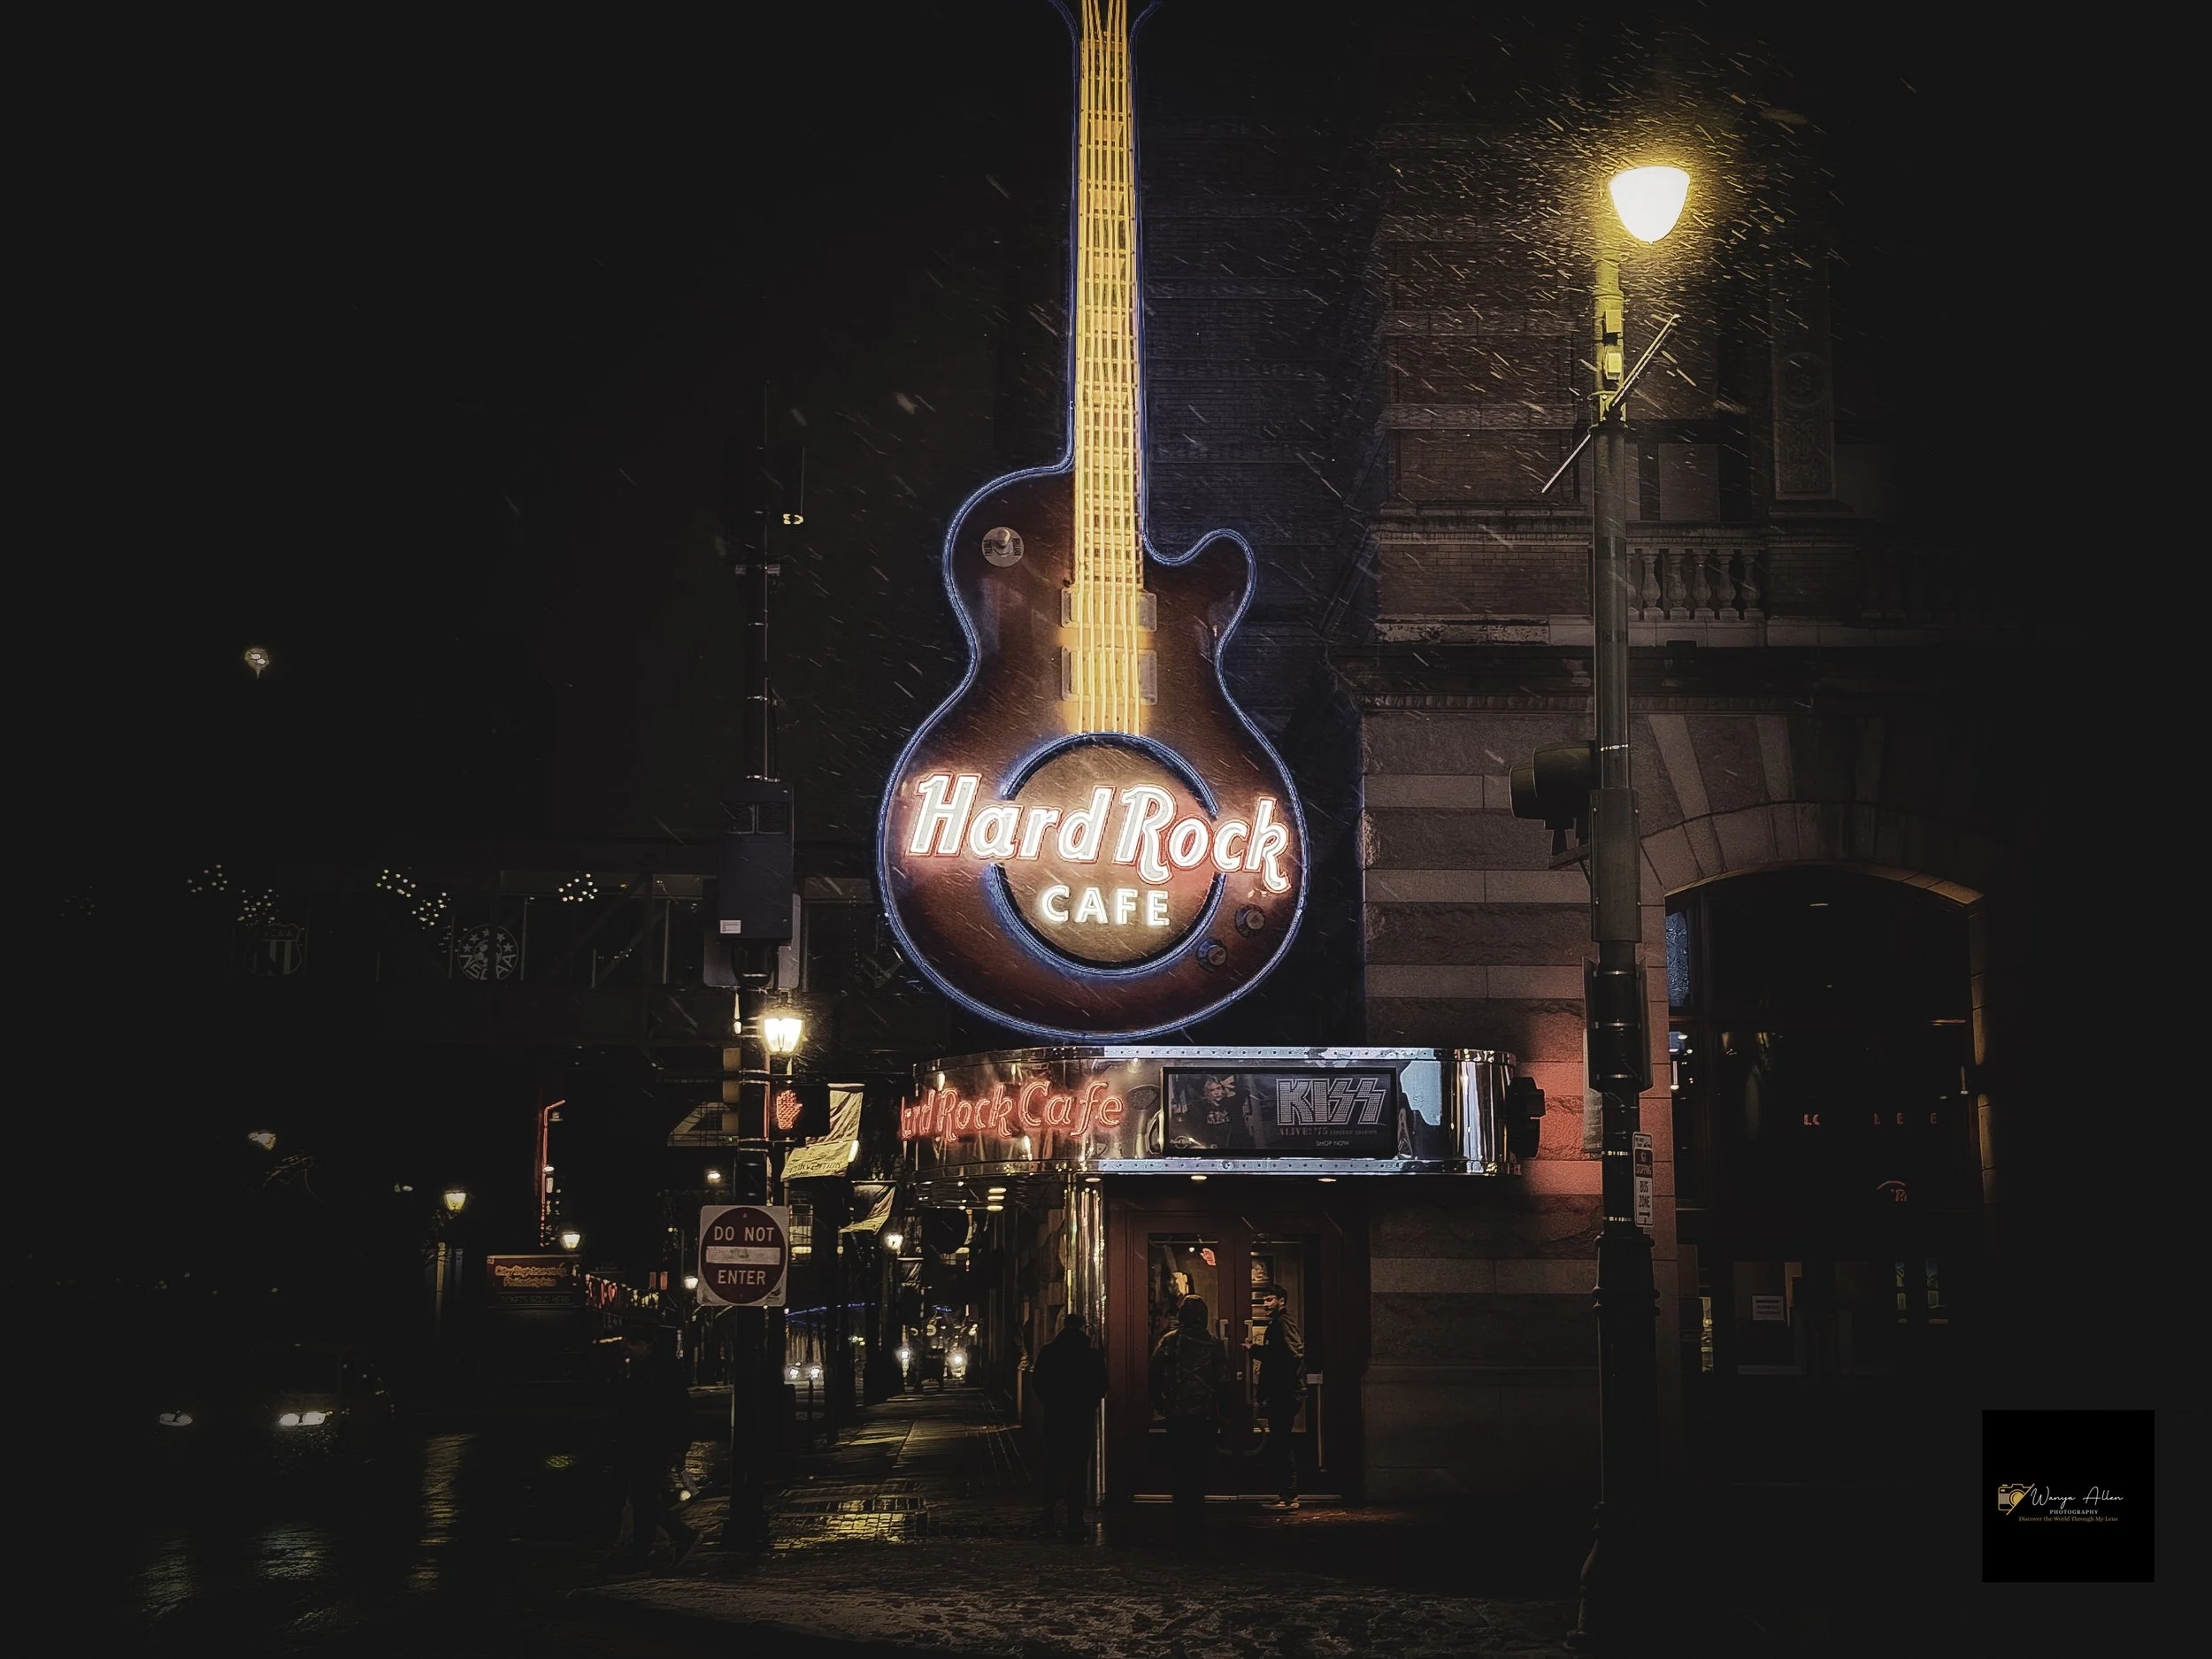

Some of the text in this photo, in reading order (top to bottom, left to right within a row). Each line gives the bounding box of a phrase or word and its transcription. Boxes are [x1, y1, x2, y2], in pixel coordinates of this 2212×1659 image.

[905, 772, 1293, 894] Hard Rock
[1041, 886, 1171, 926] CAFE
[937, 1084, 1014, 1143] Rock
[1021, 1081, 1124, 1136] Cafe
[1276, 1078, 1386, 1125] KISS
[713, 1225, 775, 1241] DO NOT
[718, 1269, 766, 1285] ENTER
